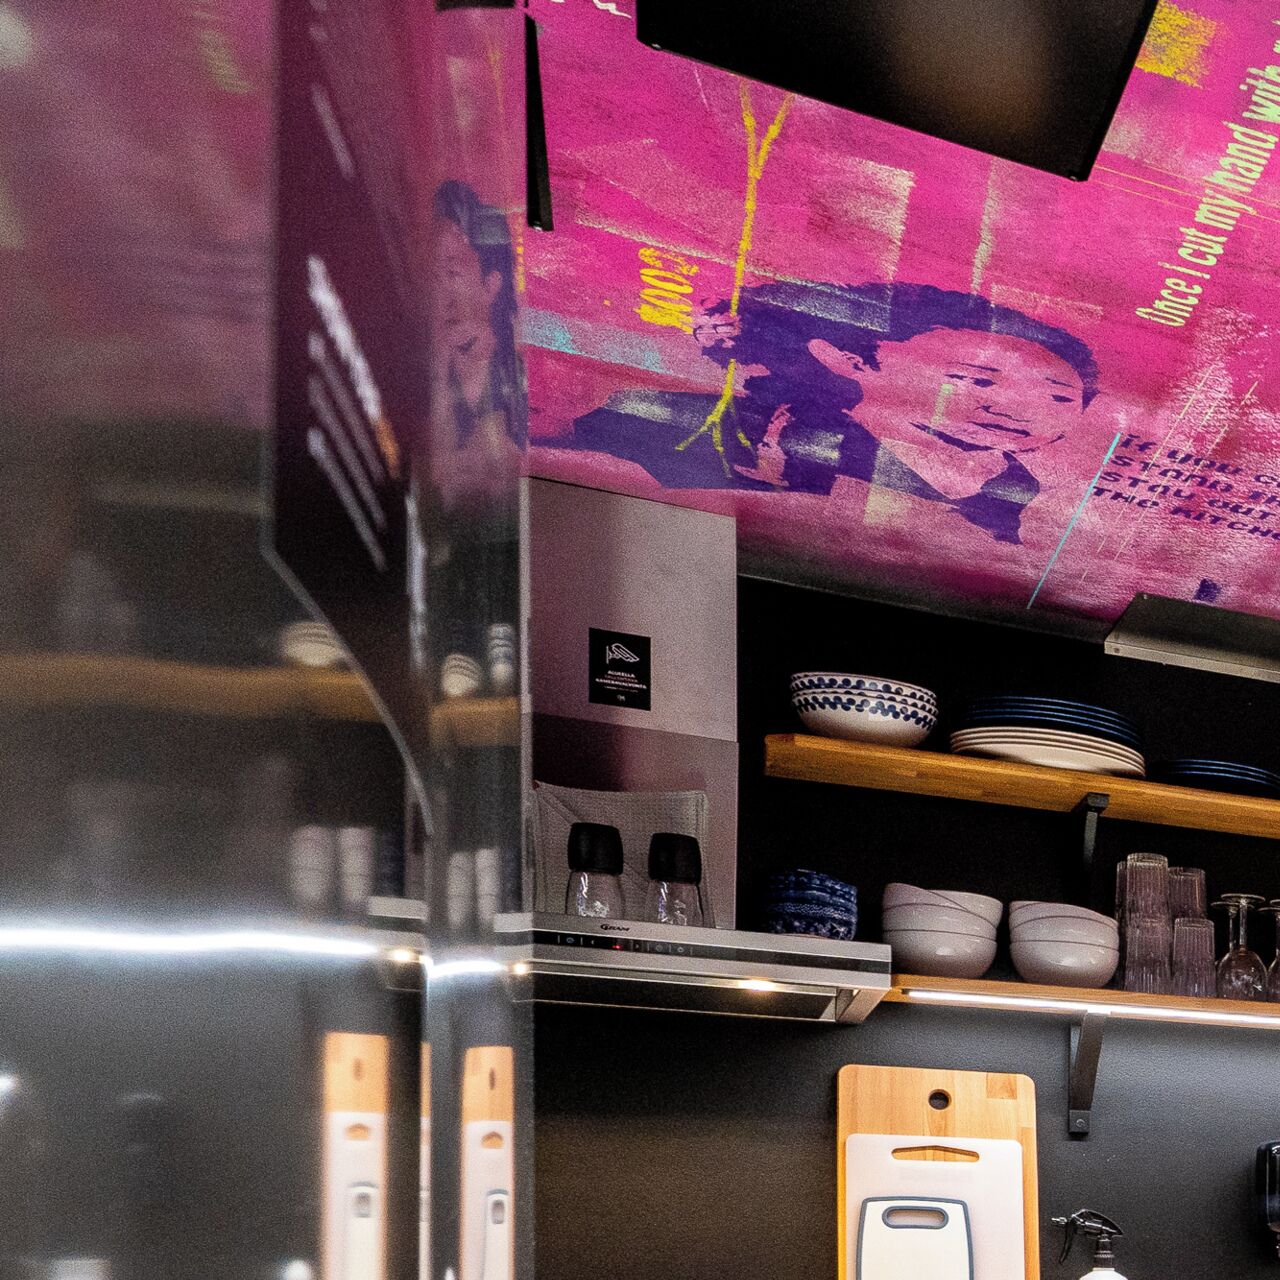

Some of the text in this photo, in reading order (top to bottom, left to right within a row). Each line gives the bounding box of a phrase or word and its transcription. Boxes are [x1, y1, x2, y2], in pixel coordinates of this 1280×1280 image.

[1203, 120, 1279, 193] hand
[1195, 189, 1257, 231] my
[1178, 226, 1228, 266] cut
[1136, 277, 1203, 327] Once
